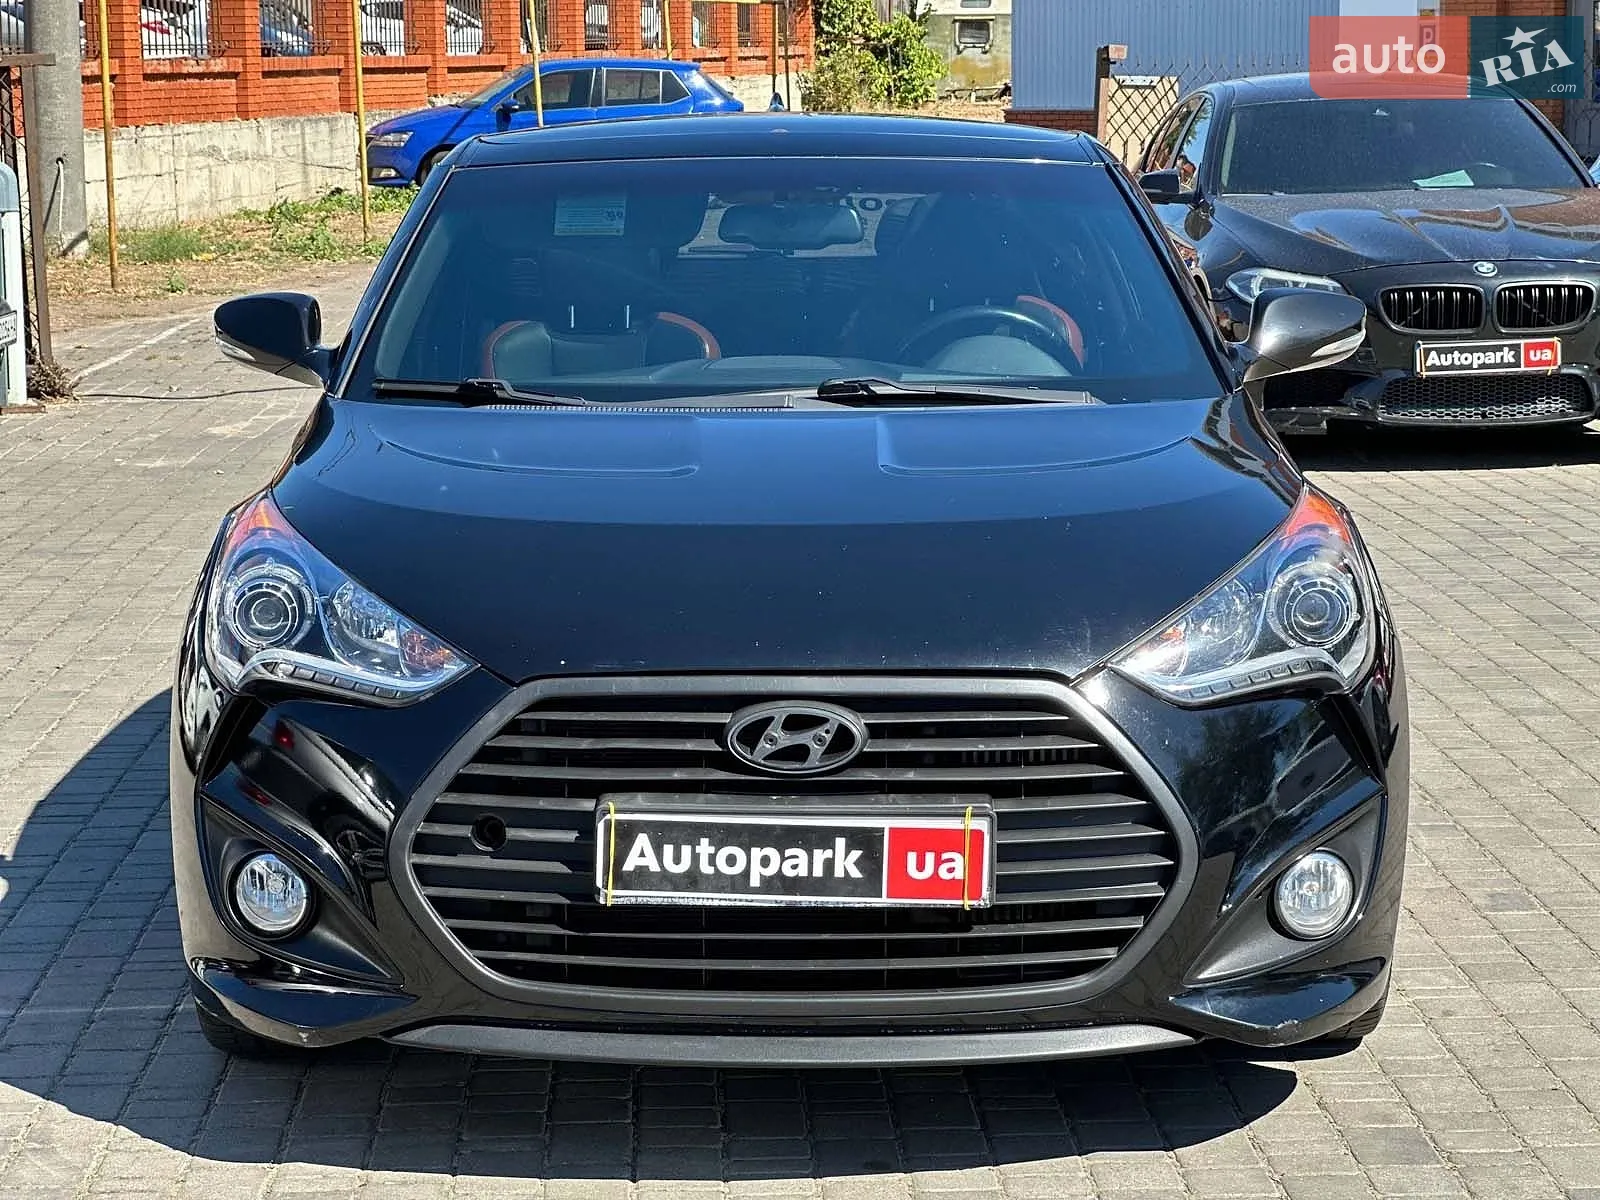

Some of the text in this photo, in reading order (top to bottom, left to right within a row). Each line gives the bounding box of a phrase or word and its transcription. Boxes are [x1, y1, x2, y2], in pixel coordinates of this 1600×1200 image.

[1425, 347, 1553, 368] Autopark ua
[622, 832, 965, 888] Autopark ua
